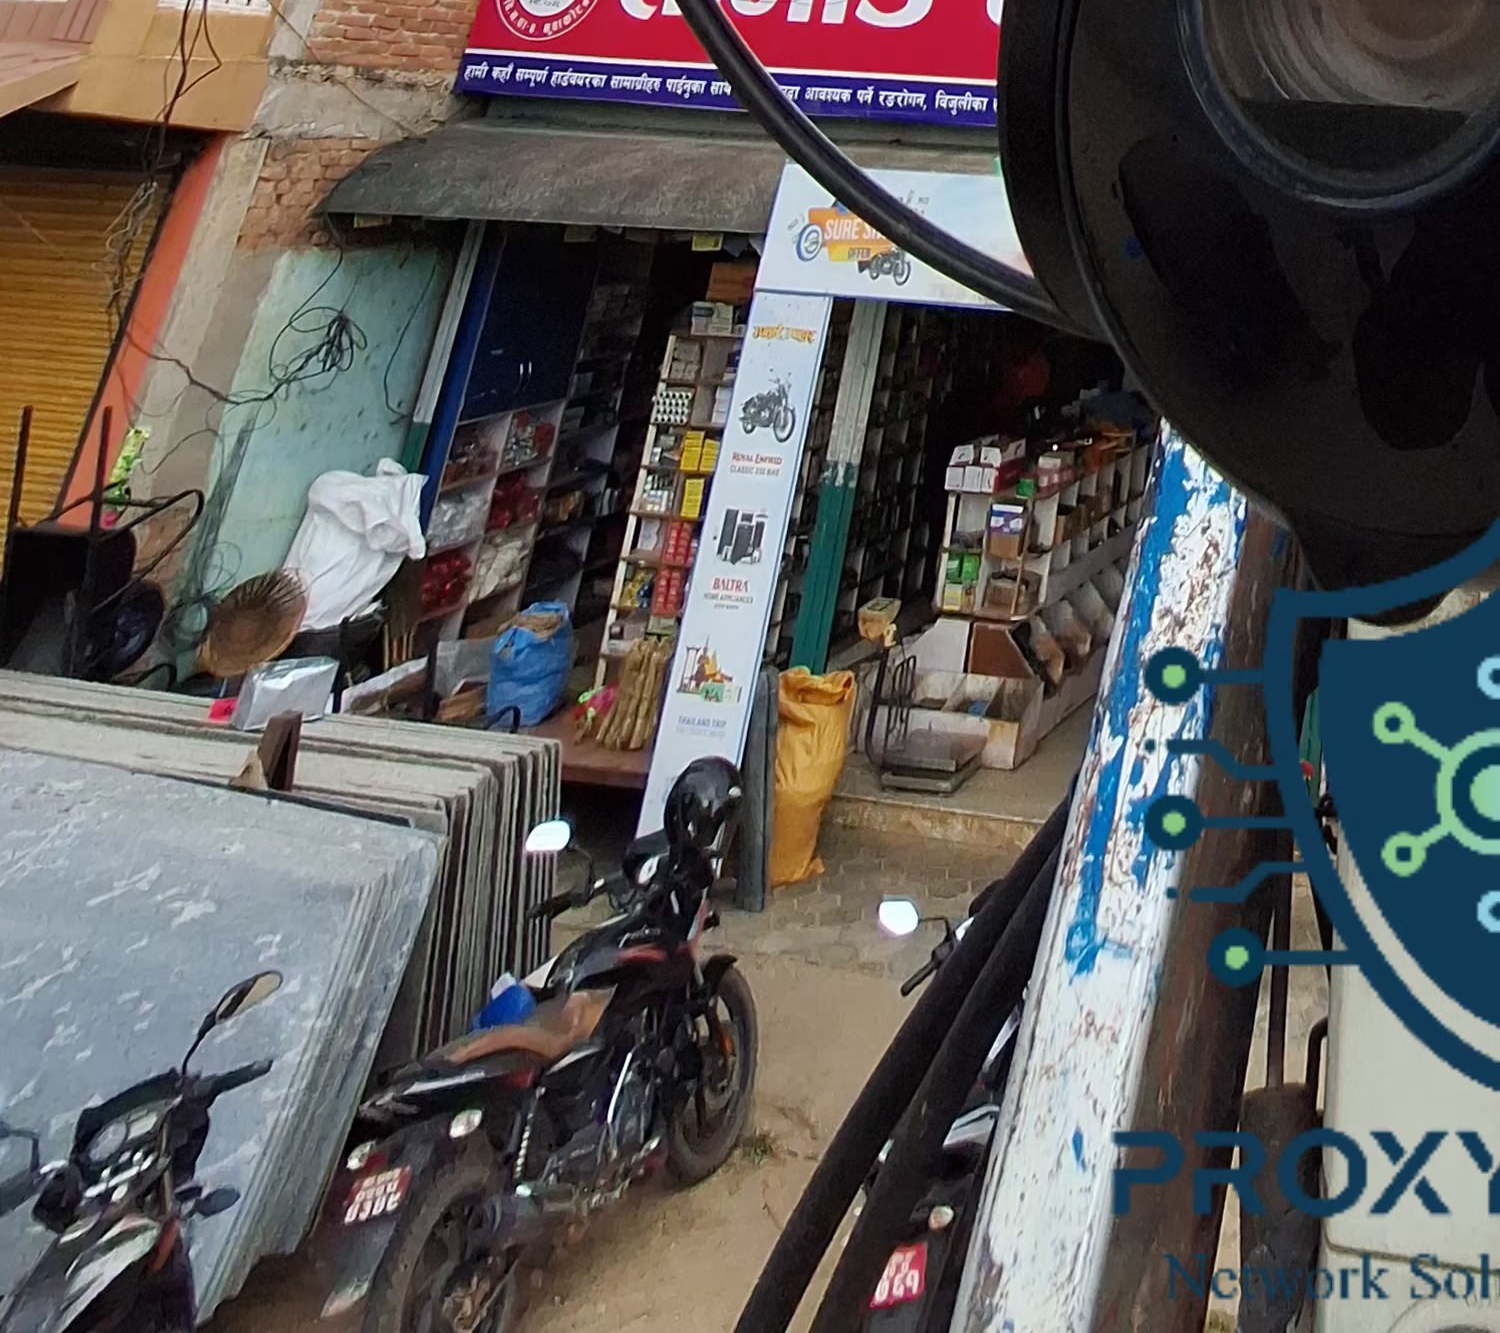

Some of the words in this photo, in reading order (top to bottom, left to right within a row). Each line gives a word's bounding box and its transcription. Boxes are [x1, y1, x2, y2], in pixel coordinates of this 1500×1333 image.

[464, 61, 488, 81] हामी
[515, 65, 549, 87] सम्पूर्ण
[805, 86, 852, 103] आवश्यक
[824, 218, 862, 241] SURE
[712, 577, 750, 593] BALTRA
